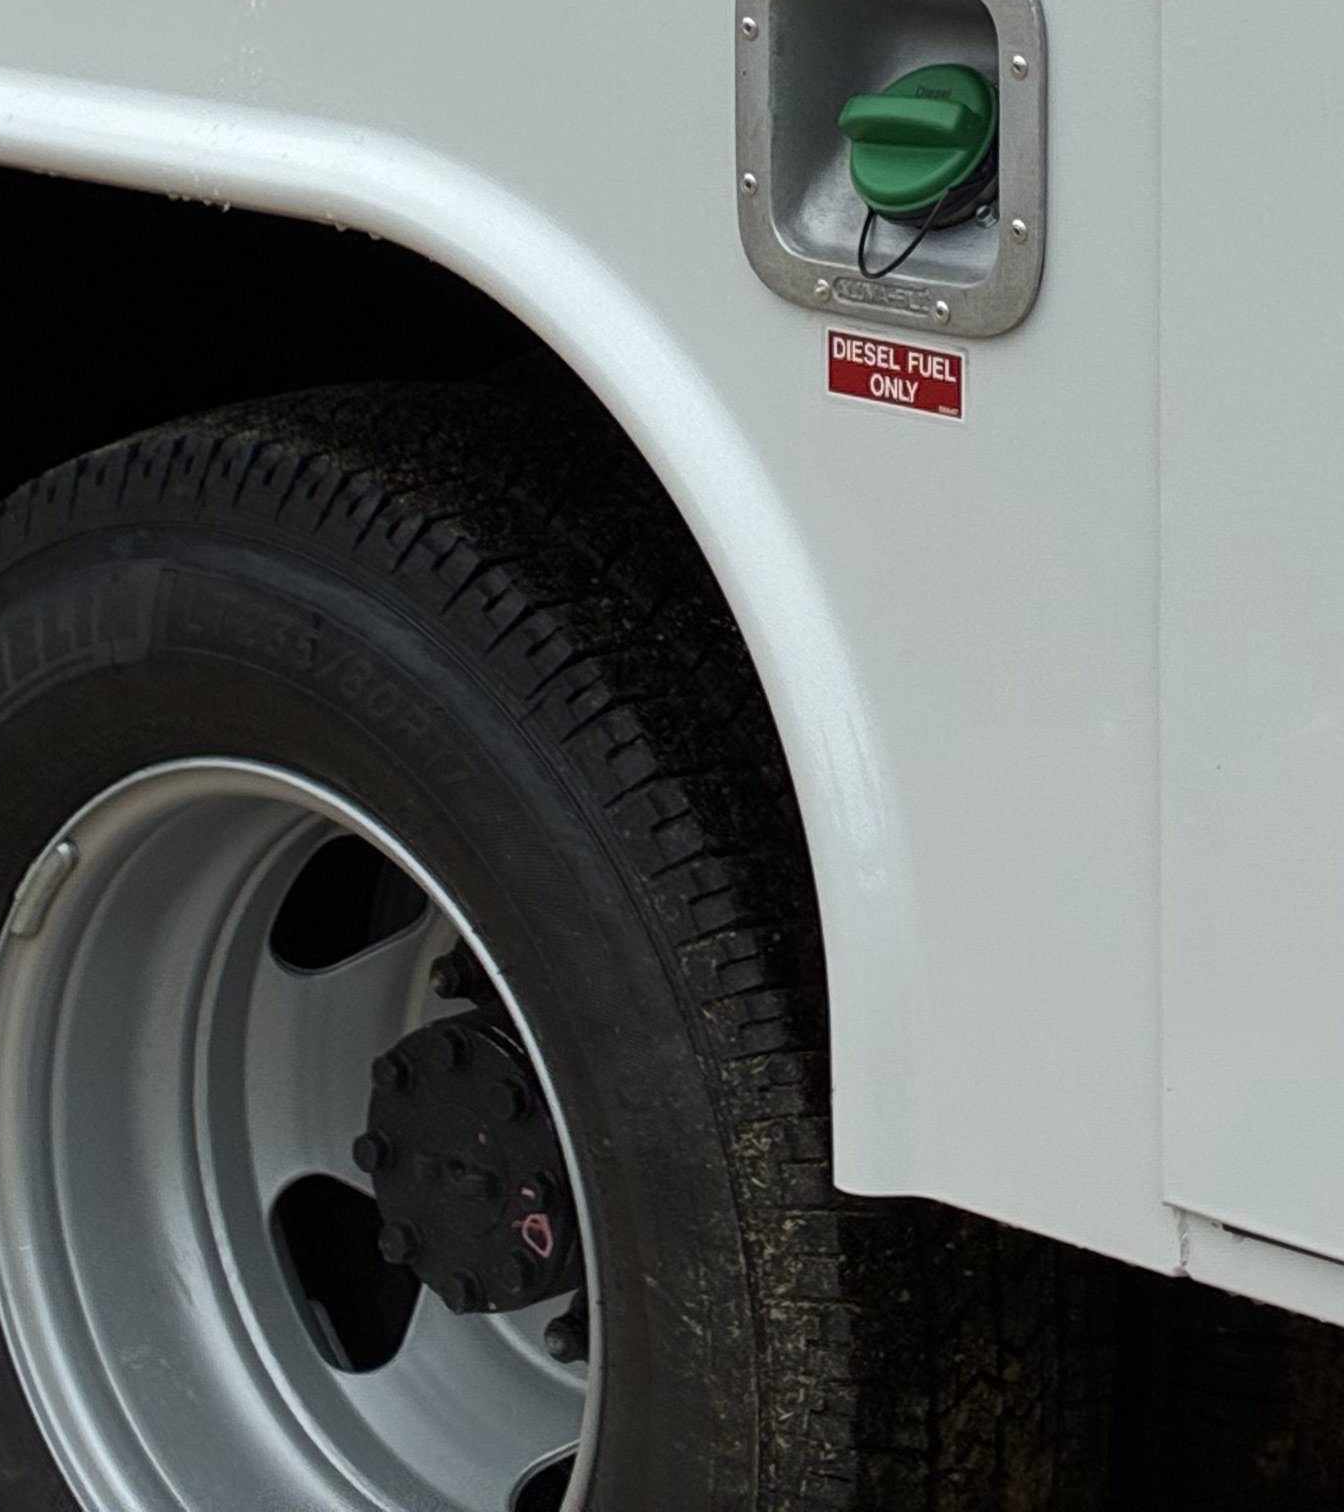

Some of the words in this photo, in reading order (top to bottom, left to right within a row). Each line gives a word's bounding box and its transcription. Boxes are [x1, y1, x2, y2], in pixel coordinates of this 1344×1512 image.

[832, 336, 901, 371] DIESEL
[908, 351, 957, 382] FUEL
[869, 373, 919, 403] ONLY
